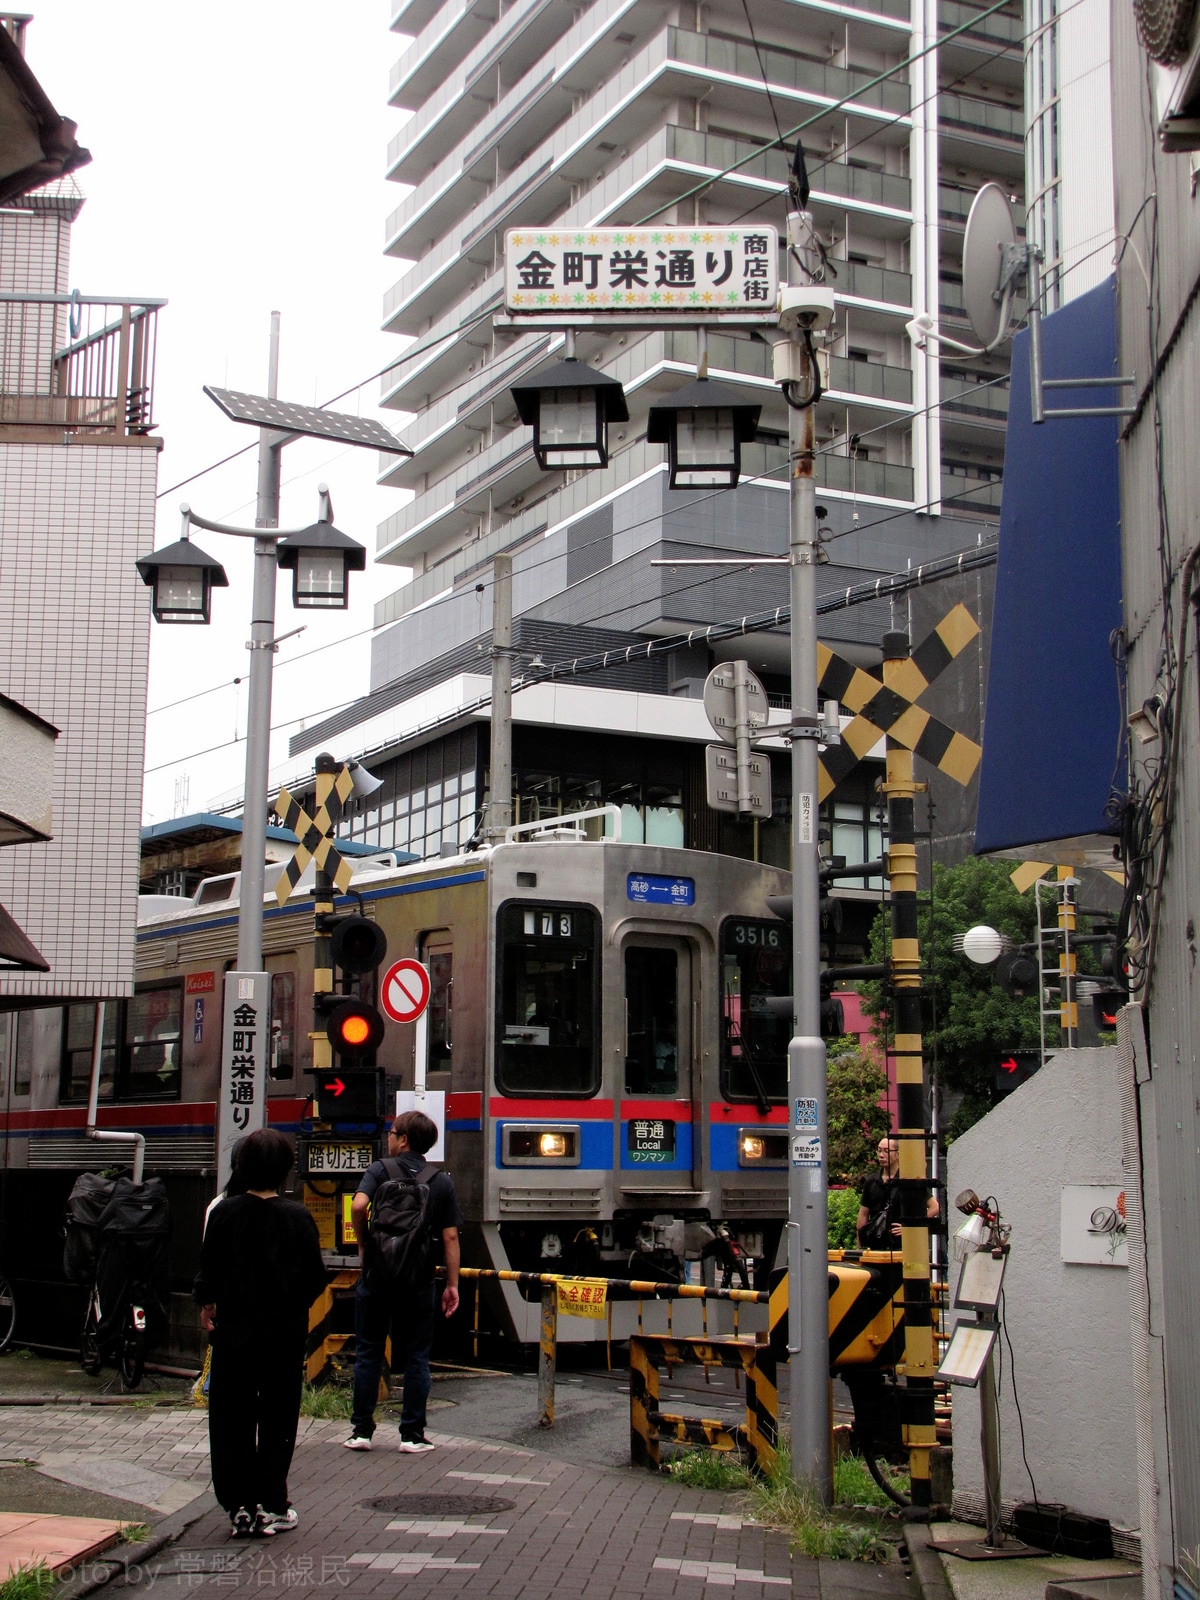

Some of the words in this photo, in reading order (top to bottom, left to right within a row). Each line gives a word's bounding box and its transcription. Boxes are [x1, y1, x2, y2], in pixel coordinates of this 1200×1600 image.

[515, 250, 734, 290] 金町栄通り
[743, 234, 769, 301] 商店街
[630, 880, 649, 893] 高砂
[671, 884, 689, 897] 金町
[735, 926, 778, 946] 3516
[187, 976, 214, 991] Keisei
[230, 1003, 257, 1131] 金町栄通り
[797, 1100, 815, 1109] 防犯
[634, 1120, 665, 1139] 普通
[637, 1140, 661, 1150] Local
[309, 1145, 373, 1169] 踏切注意
[632, 1152, 666, 1162] ワンマン
